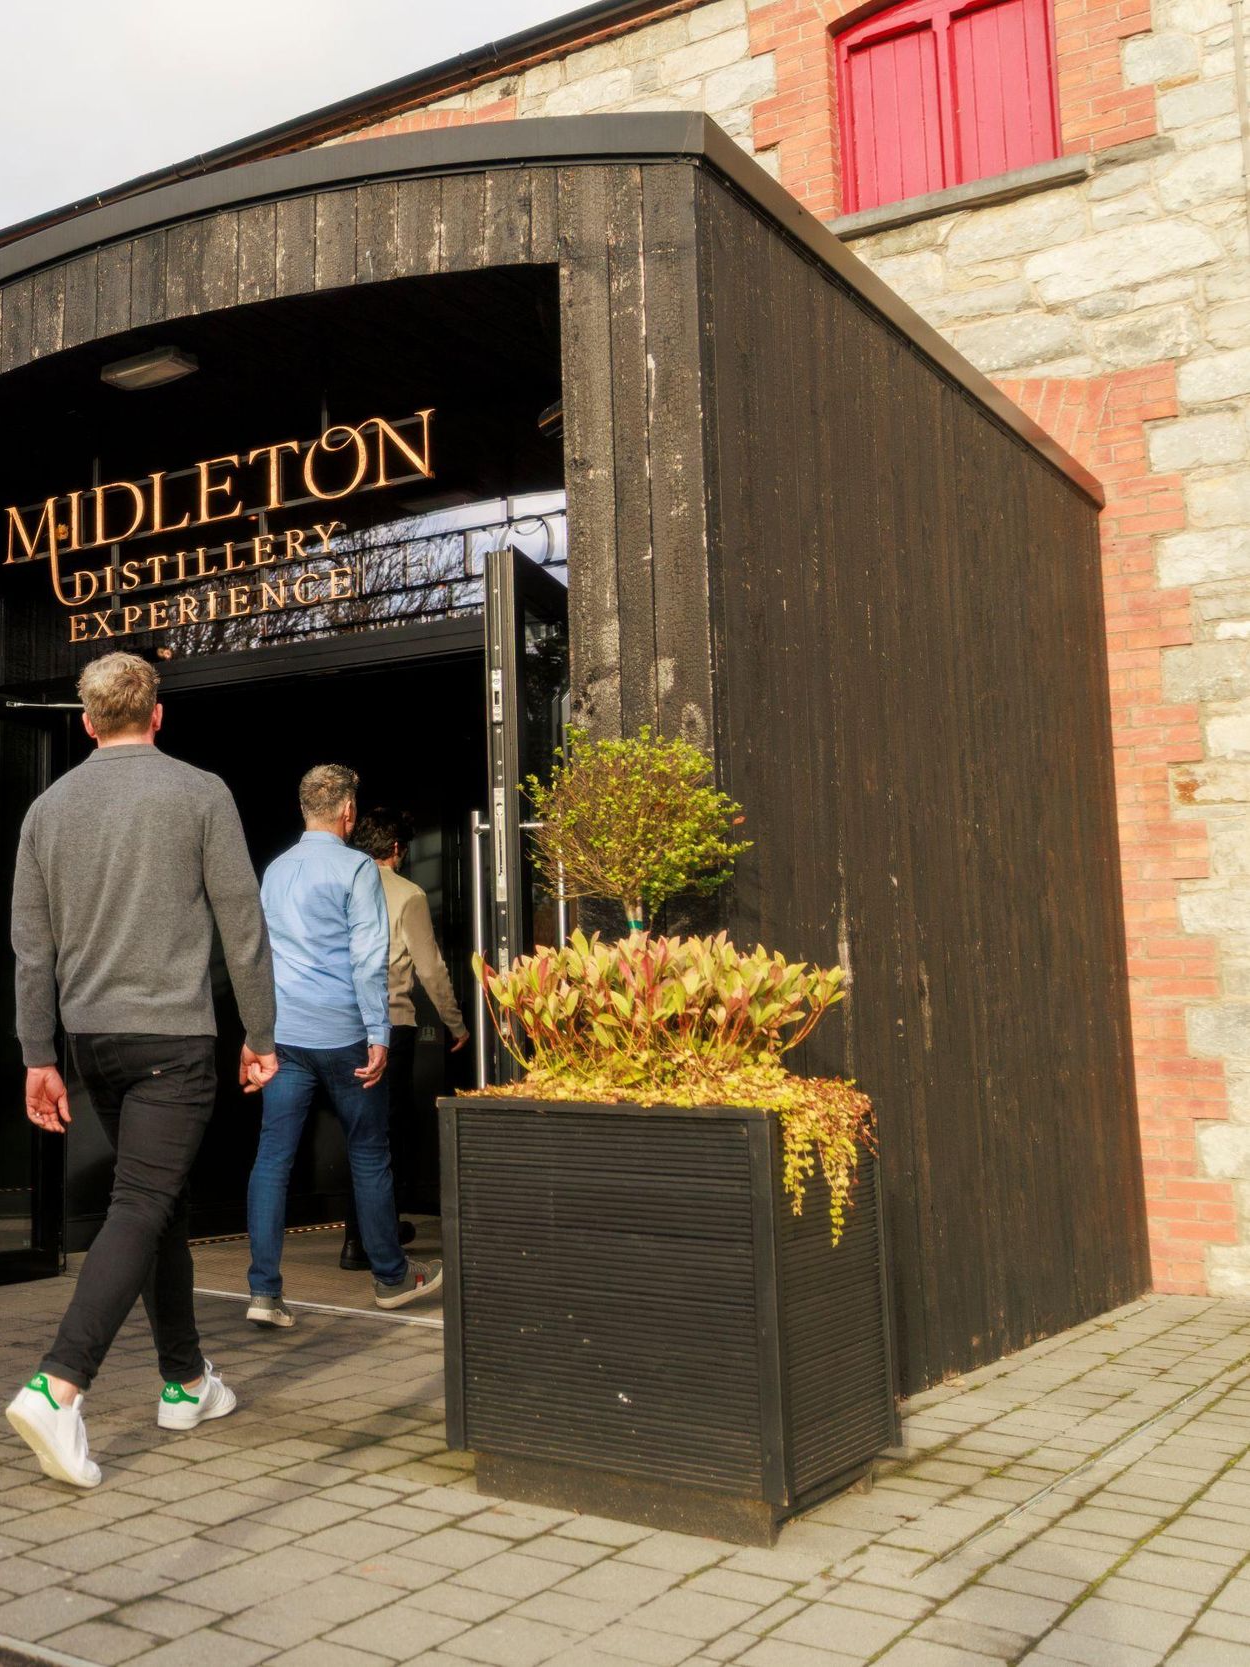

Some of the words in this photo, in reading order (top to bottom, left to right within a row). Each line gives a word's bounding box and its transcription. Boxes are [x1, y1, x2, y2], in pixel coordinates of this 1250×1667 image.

[2, 409, 436, 606] MIDLETON
[73, 521, 342, 599] DISTILLERY
[69, 567, 354, 643] EXPERIENCE
